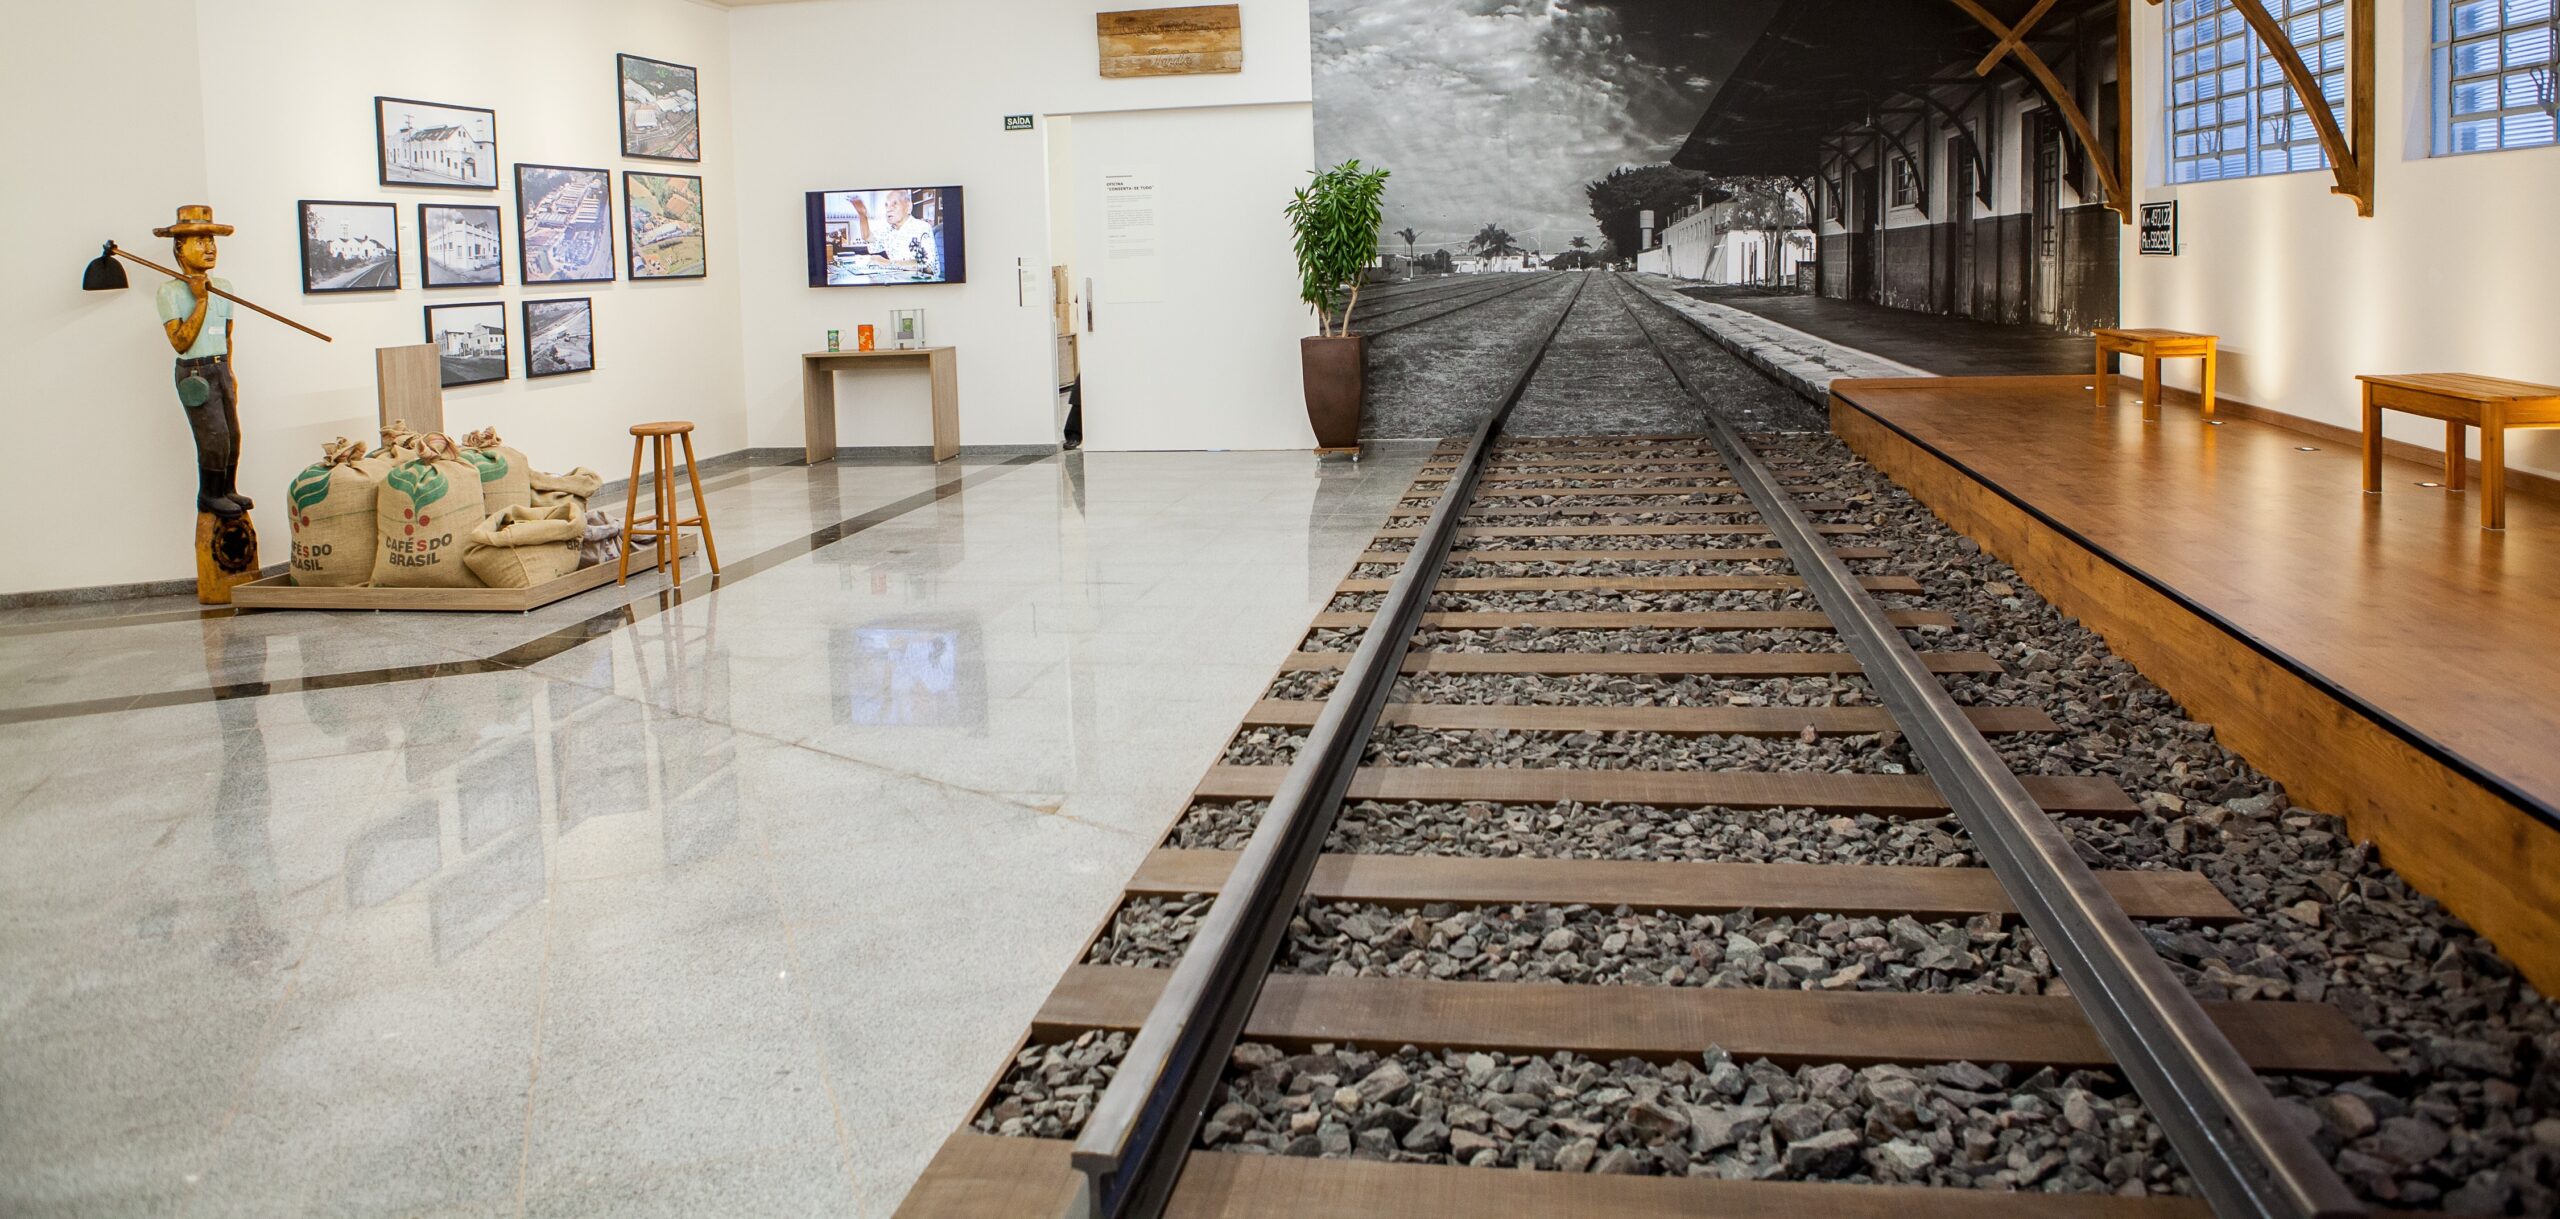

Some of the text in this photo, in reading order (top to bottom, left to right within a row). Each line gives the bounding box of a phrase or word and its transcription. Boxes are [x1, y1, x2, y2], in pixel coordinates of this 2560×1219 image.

[1007, 116, 1031, 126] SAÍDA
[430, 533, 452, 550] DO
[312, 544, 332, 556] DO
[389, 552, 440, 567] BRASIL
